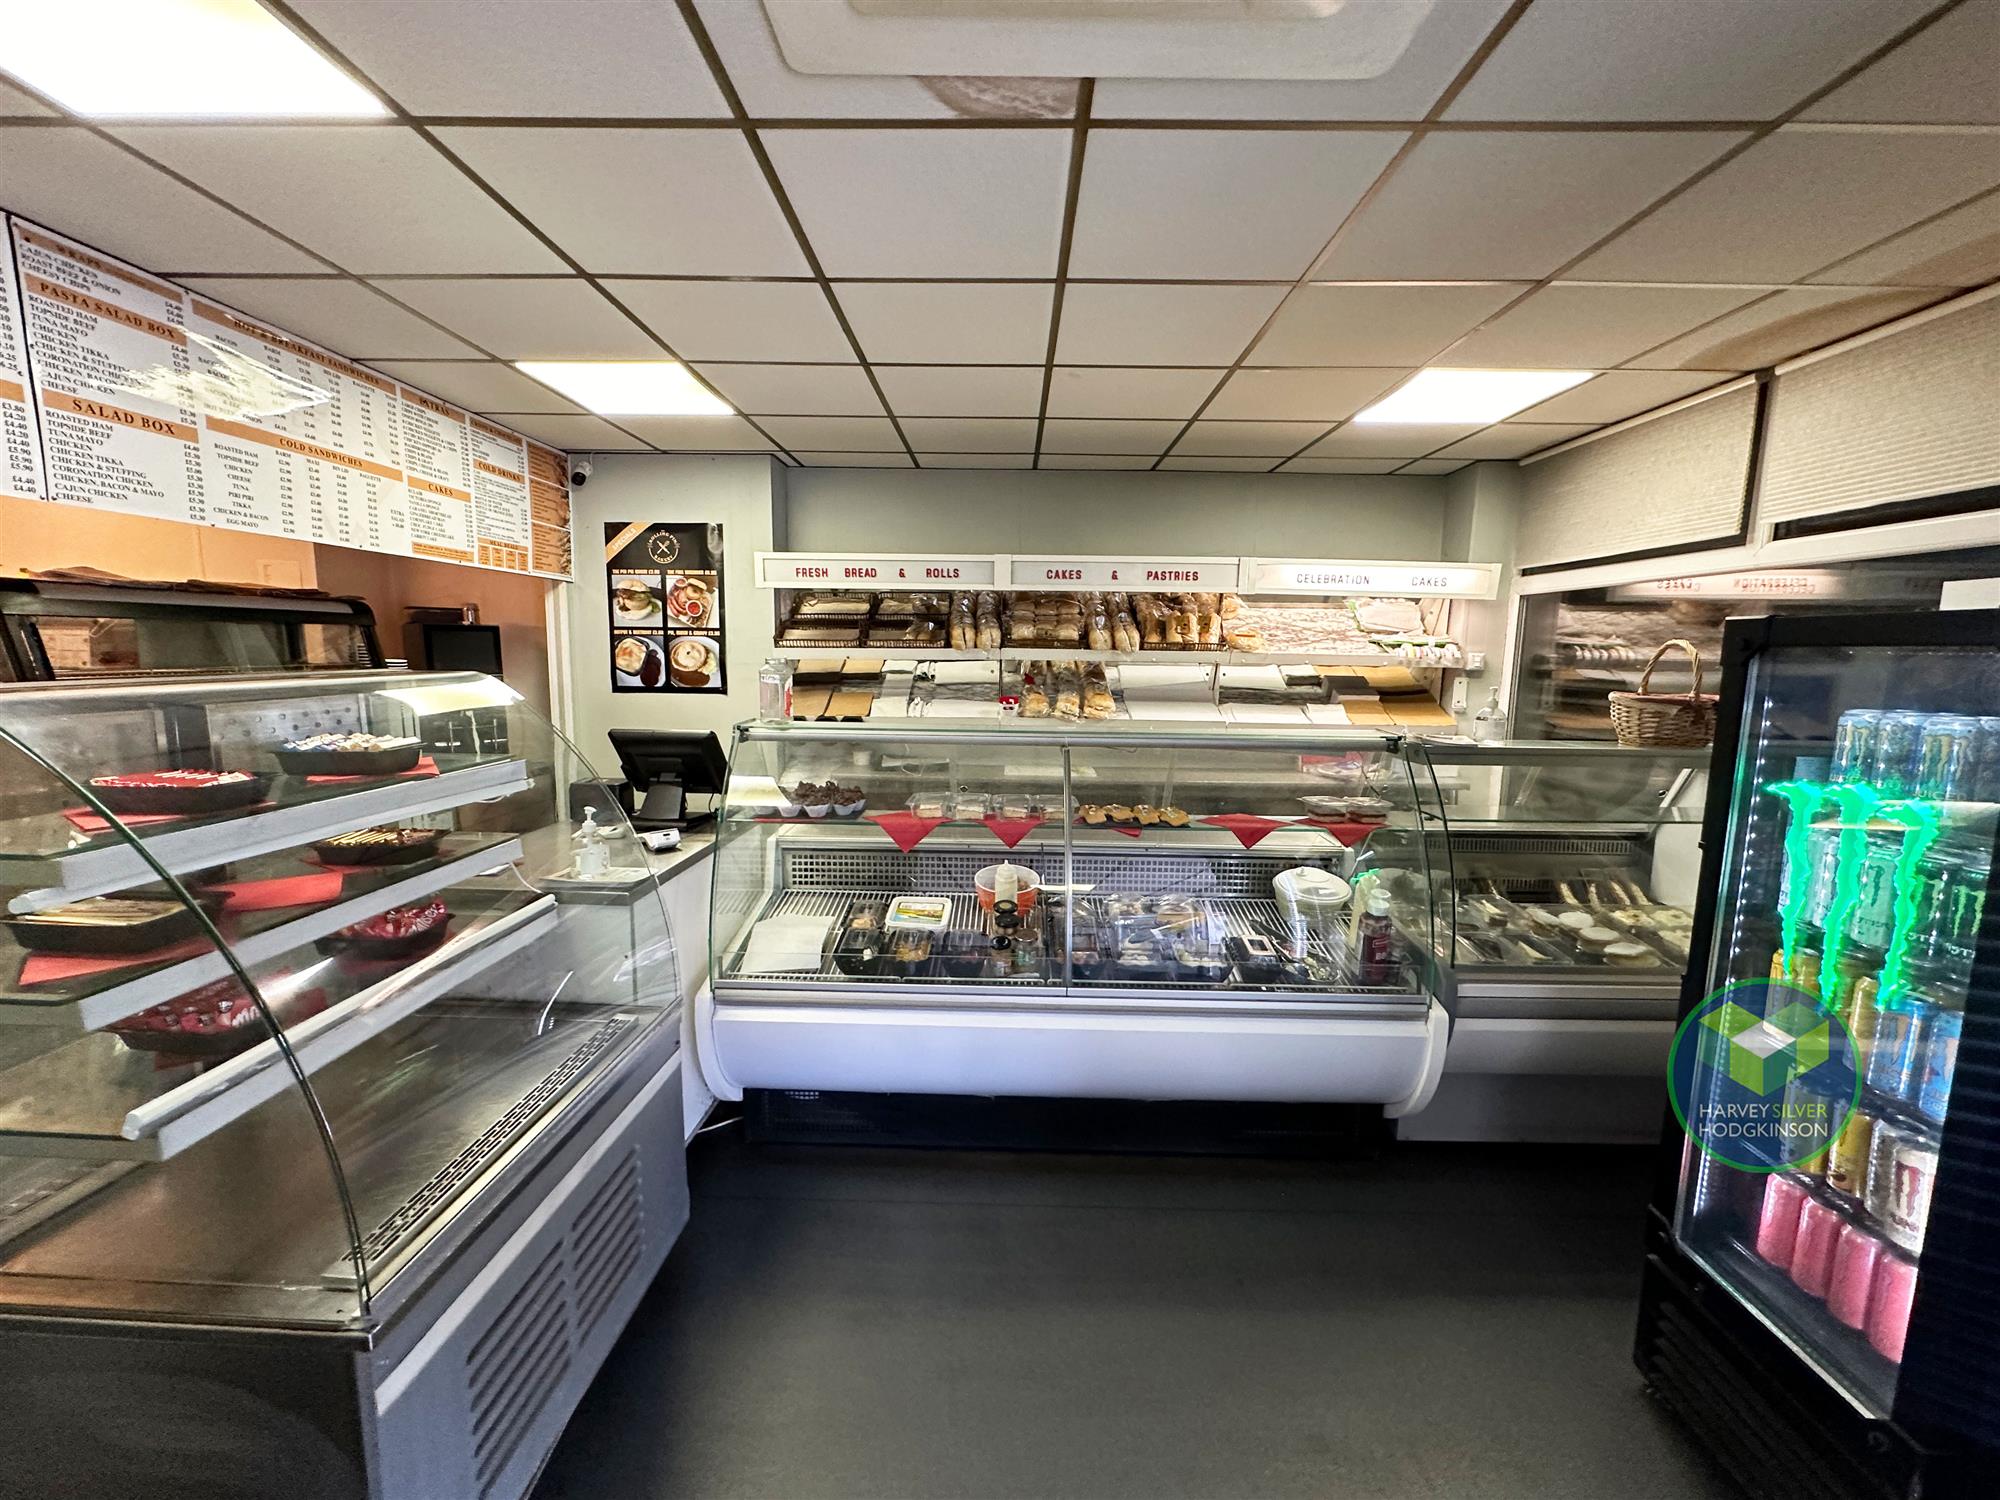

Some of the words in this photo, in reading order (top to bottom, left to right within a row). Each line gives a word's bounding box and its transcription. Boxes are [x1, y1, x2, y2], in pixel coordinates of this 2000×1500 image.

[28, 294, 73, 315] ROASTED
[76, 311, 97, 323] HAM
[30, 303, 70, 322] TOPSIDE
[73, 318, 95, 331] BEEF
[40, 281, 89, 308] PASTA
[95, 302, 141, 327] SALAD
[147, 321, 174, 339] BOX
[32, 313, 57, 327] TUNA
[60, 322, 88, 337] MAYO
[32, 322, 76, 341] CHICKEN
[34, 331, 77, 350] CHICKEN
[81, 346, 108, 360] TIKKA
[35, 340, 79, 358] CHICKEN
[36, 349, 98, 373] CORONATION
[40, 378, 77, 394] CHEESE
[3, 411, 26, 421] £4.20
[4, 420, 27, 430] £4.40
[46, 410, 89, 425] ROASTED
[92, 421, 112, 431] HAM
[73, 399, 134, 424] SALAD
[142, 417, 174, 434] BOX
[6, 428, 28, 439] £4.20
[47, 419, 85, 433] TOPSIDE
[88, 429, 111, 439] BEEF
[48, 428, 74, 439] TUNA
[76, 434, 102, 445] MAYO
[7, 437, 30, 447] £4.40
[49, 437, 91, 451] CHICKEN
[50, 446, 92, 460] CHICKEN
[95, 455, 123, 465] TIKKA
[51, 454, 93, 468] CHICKEN
[106, 465, 146, 478] STUFFING
[13, 475, 35, 485] £4.40
[52, 464, 112, 480] CORONATION
[116, 476, 152, 487] CHICKEN
[14, 484, 36, 493] £4.40
[55, 482, 85, 493] CAJUN
[88, 488, 127, 500] CHICKEN
[55, 492, 92, 503] CHEESE
[101, 481, 129, 491] BACON
[141, 488, 164, 497] MAYO
[795, 568, 829, 578] FRESH
[844, 568, 877, 578] BREAD
[898, 568, 906, 578] &
[926, 568, 960, 579] ROLLS
[1046, 569, 1082, 580] CAKES
[1111, 570, 1119, 581] &
[1146, 570, 1199, 582] PASTRIES
[1297, 573, 1371, 586] CELEBRATION
[1411, 576, 1448, 588] CAKES
